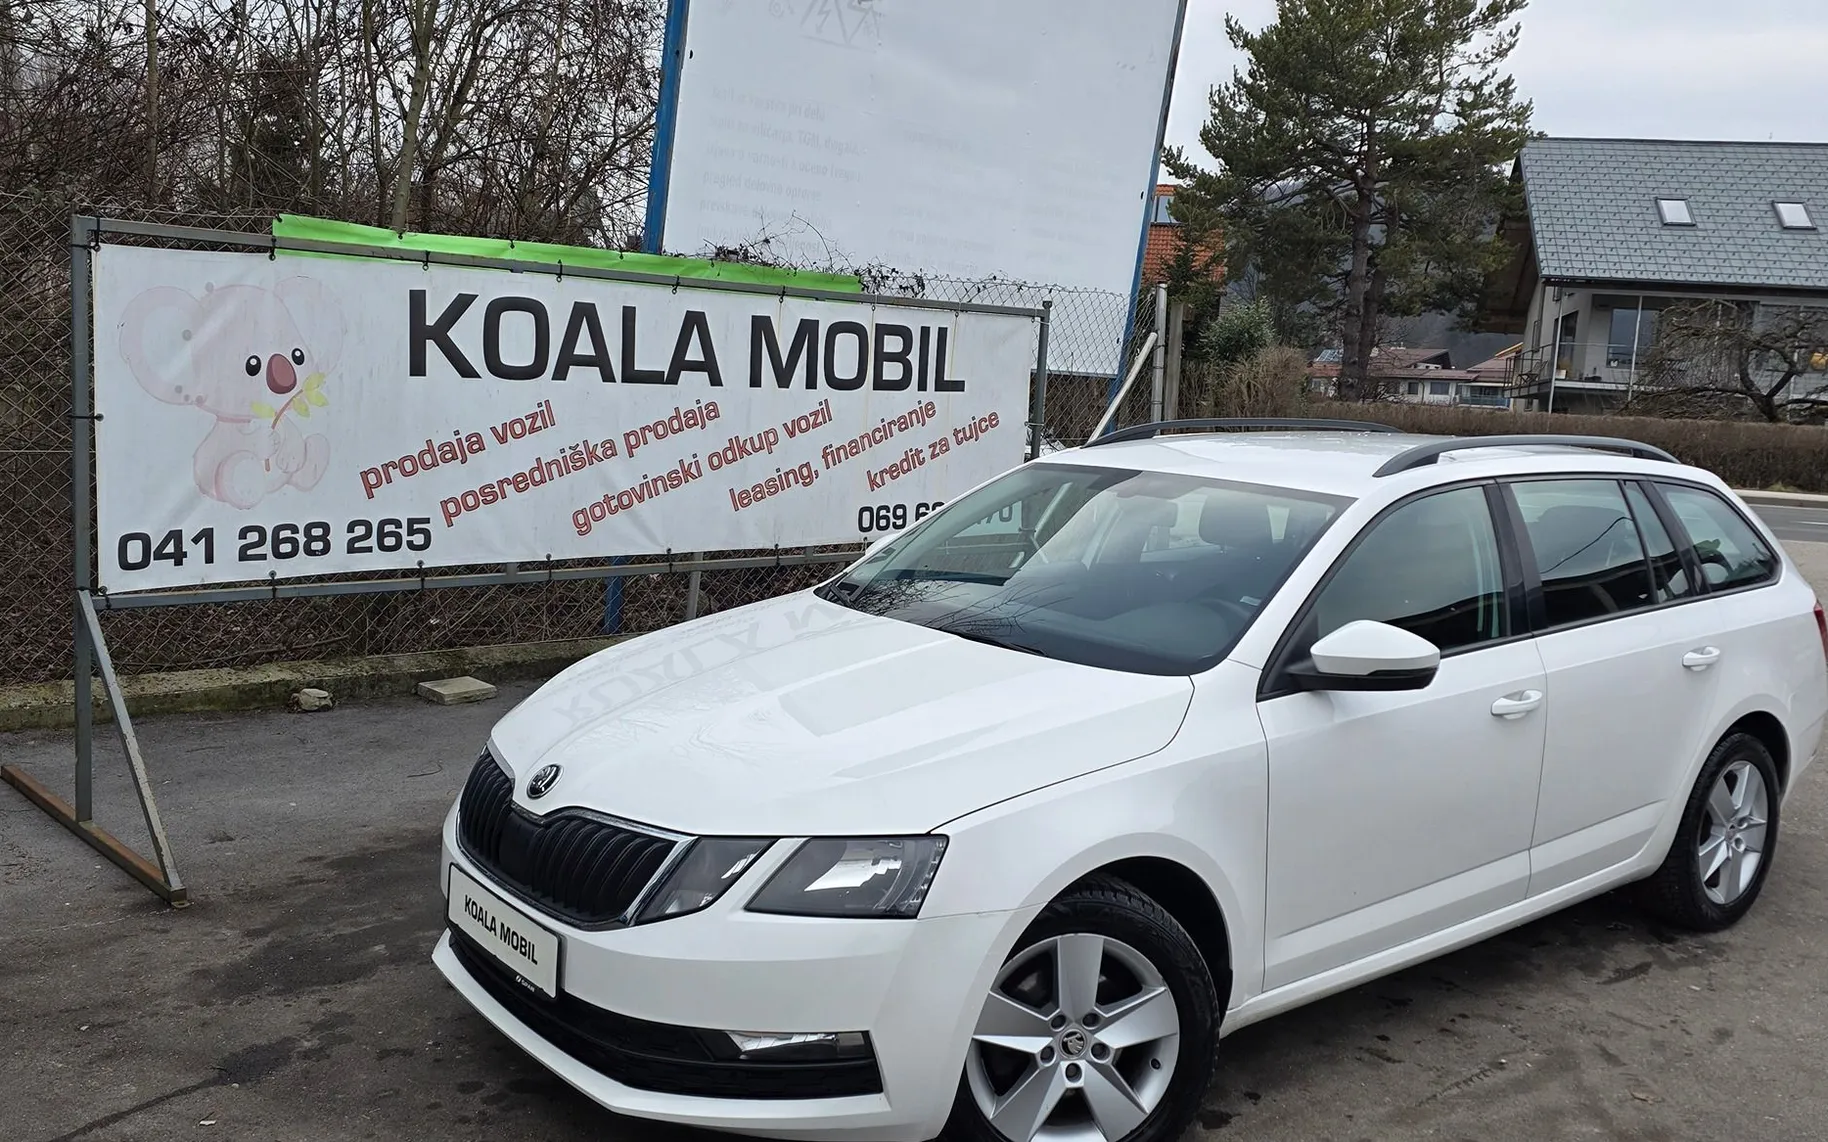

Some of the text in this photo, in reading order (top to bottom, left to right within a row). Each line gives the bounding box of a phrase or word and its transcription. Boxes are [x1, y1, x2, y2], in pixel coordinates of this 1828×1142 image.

[408, 289, 966, 392] KOALA MOBIL
[360, 400, 556, 499] prodaja vozil
[440, 399, 720, 527] posredniška prodaja
[571, 399, 833, 537] gotovinski odkup vozil
[729, 400, 936, 512] leasing, financiranje
[866, 409, 1000, 492] kredit za tujce
[117, 517, 432, 571] 041 268 265
[858, 503, 907, 533] 069
[464, 894, 537, 965] KOALA MOBIL
